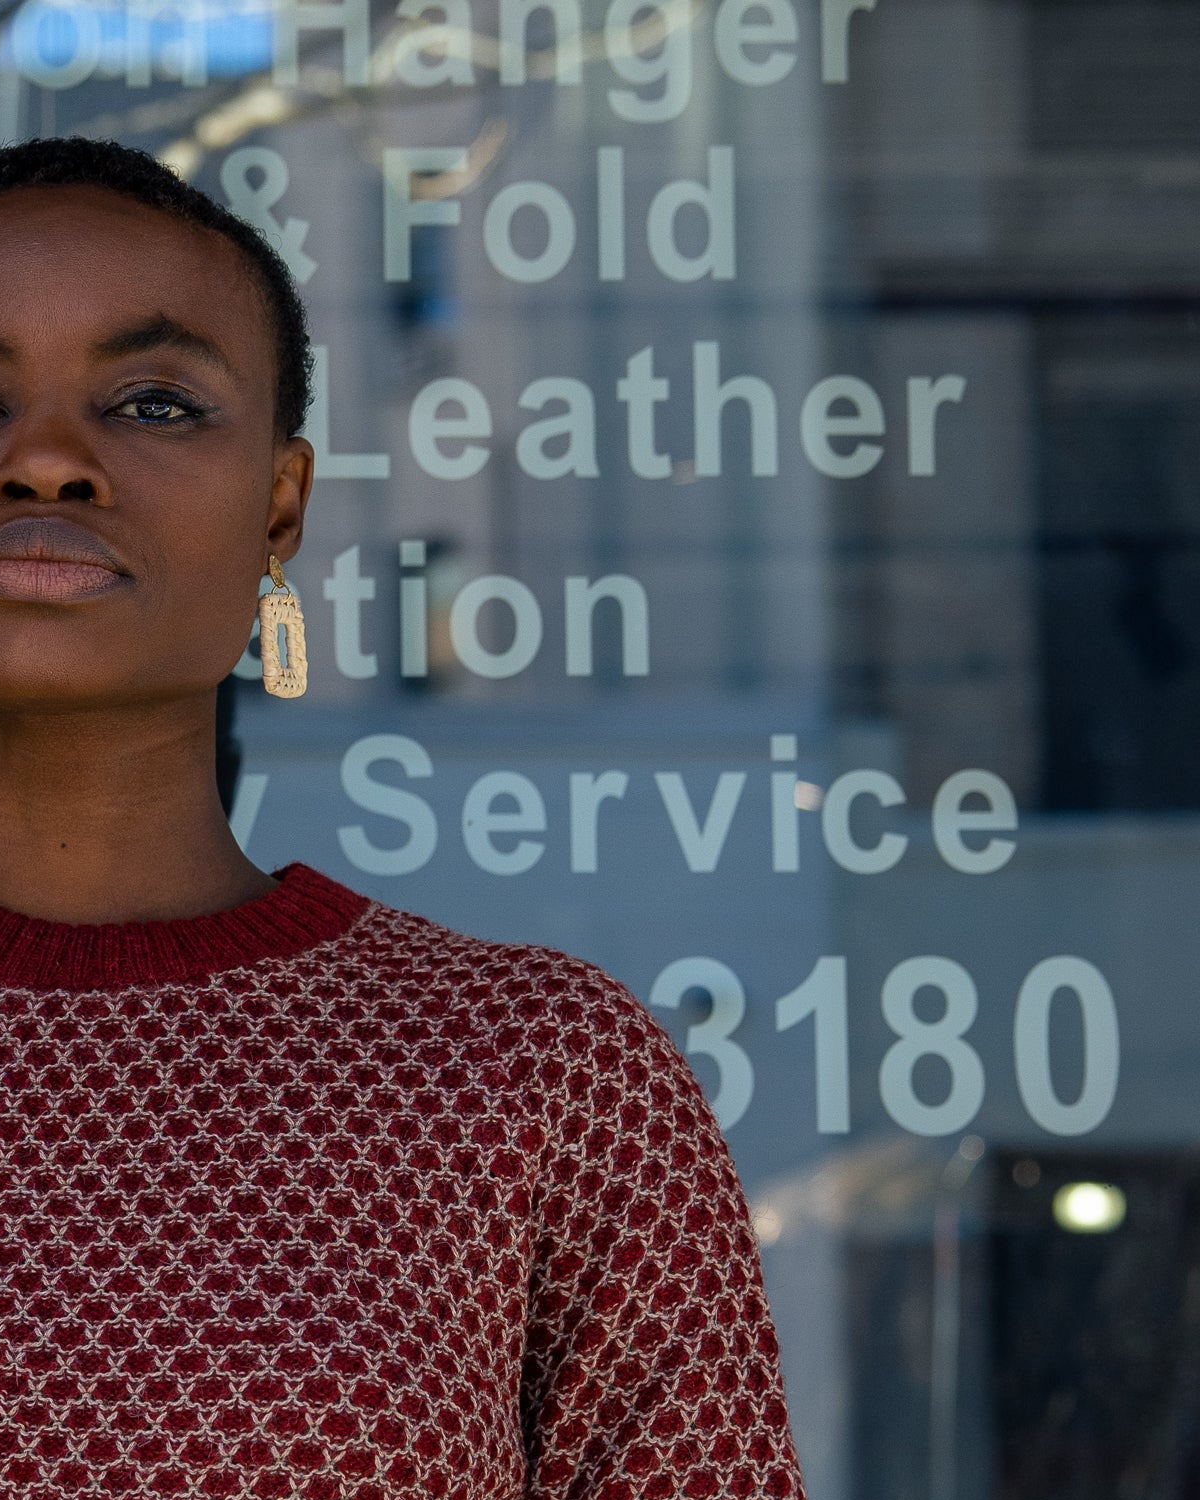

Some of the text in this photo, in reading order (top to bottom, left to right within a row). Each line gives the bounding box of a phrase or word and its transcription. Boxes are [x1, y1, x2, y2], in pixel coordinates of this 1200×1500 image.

[11, 0, 210, 91] on
[272, 0, 875, 122] Hanger
[383, 145, 737, 283] Fold
[306, 341, 966, 481] Leather
[337, 733, 1019, 876] Service
[648, 954, 1121, 1137] 3180
